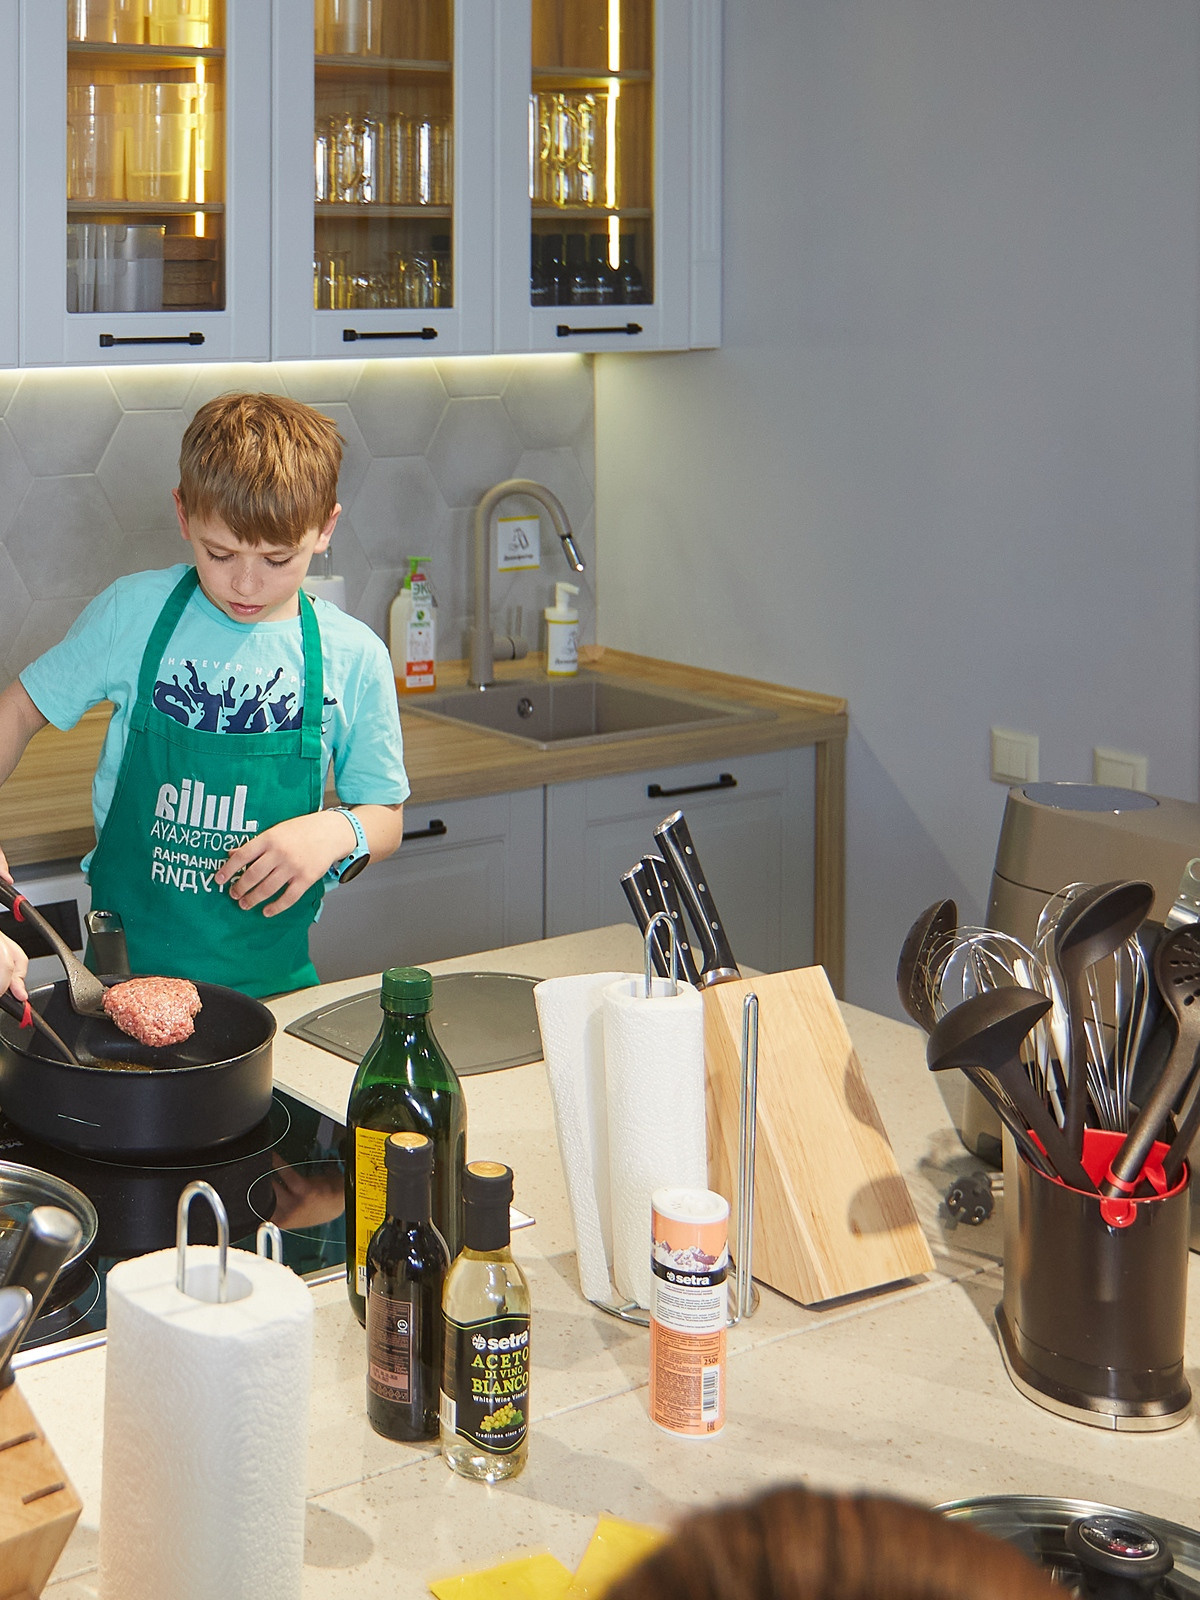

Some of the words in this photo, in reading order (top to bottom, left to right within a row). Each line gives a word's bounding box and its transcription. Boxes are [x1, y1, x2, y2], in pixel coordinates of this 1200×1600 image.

[161, 657, 243, 672] HATEVER
[676, 1275, 710, 1286] setra
[487, 1330, 529, 1351] setra
[470, 1346, 529, 1369] ACETO
[485, 1369, 497, 1379] DI
[500, 1365, 523, 1379] VINO
[471, 1371, 529, 1395] BIANCO
[472, 1394, 492, 1403] White
